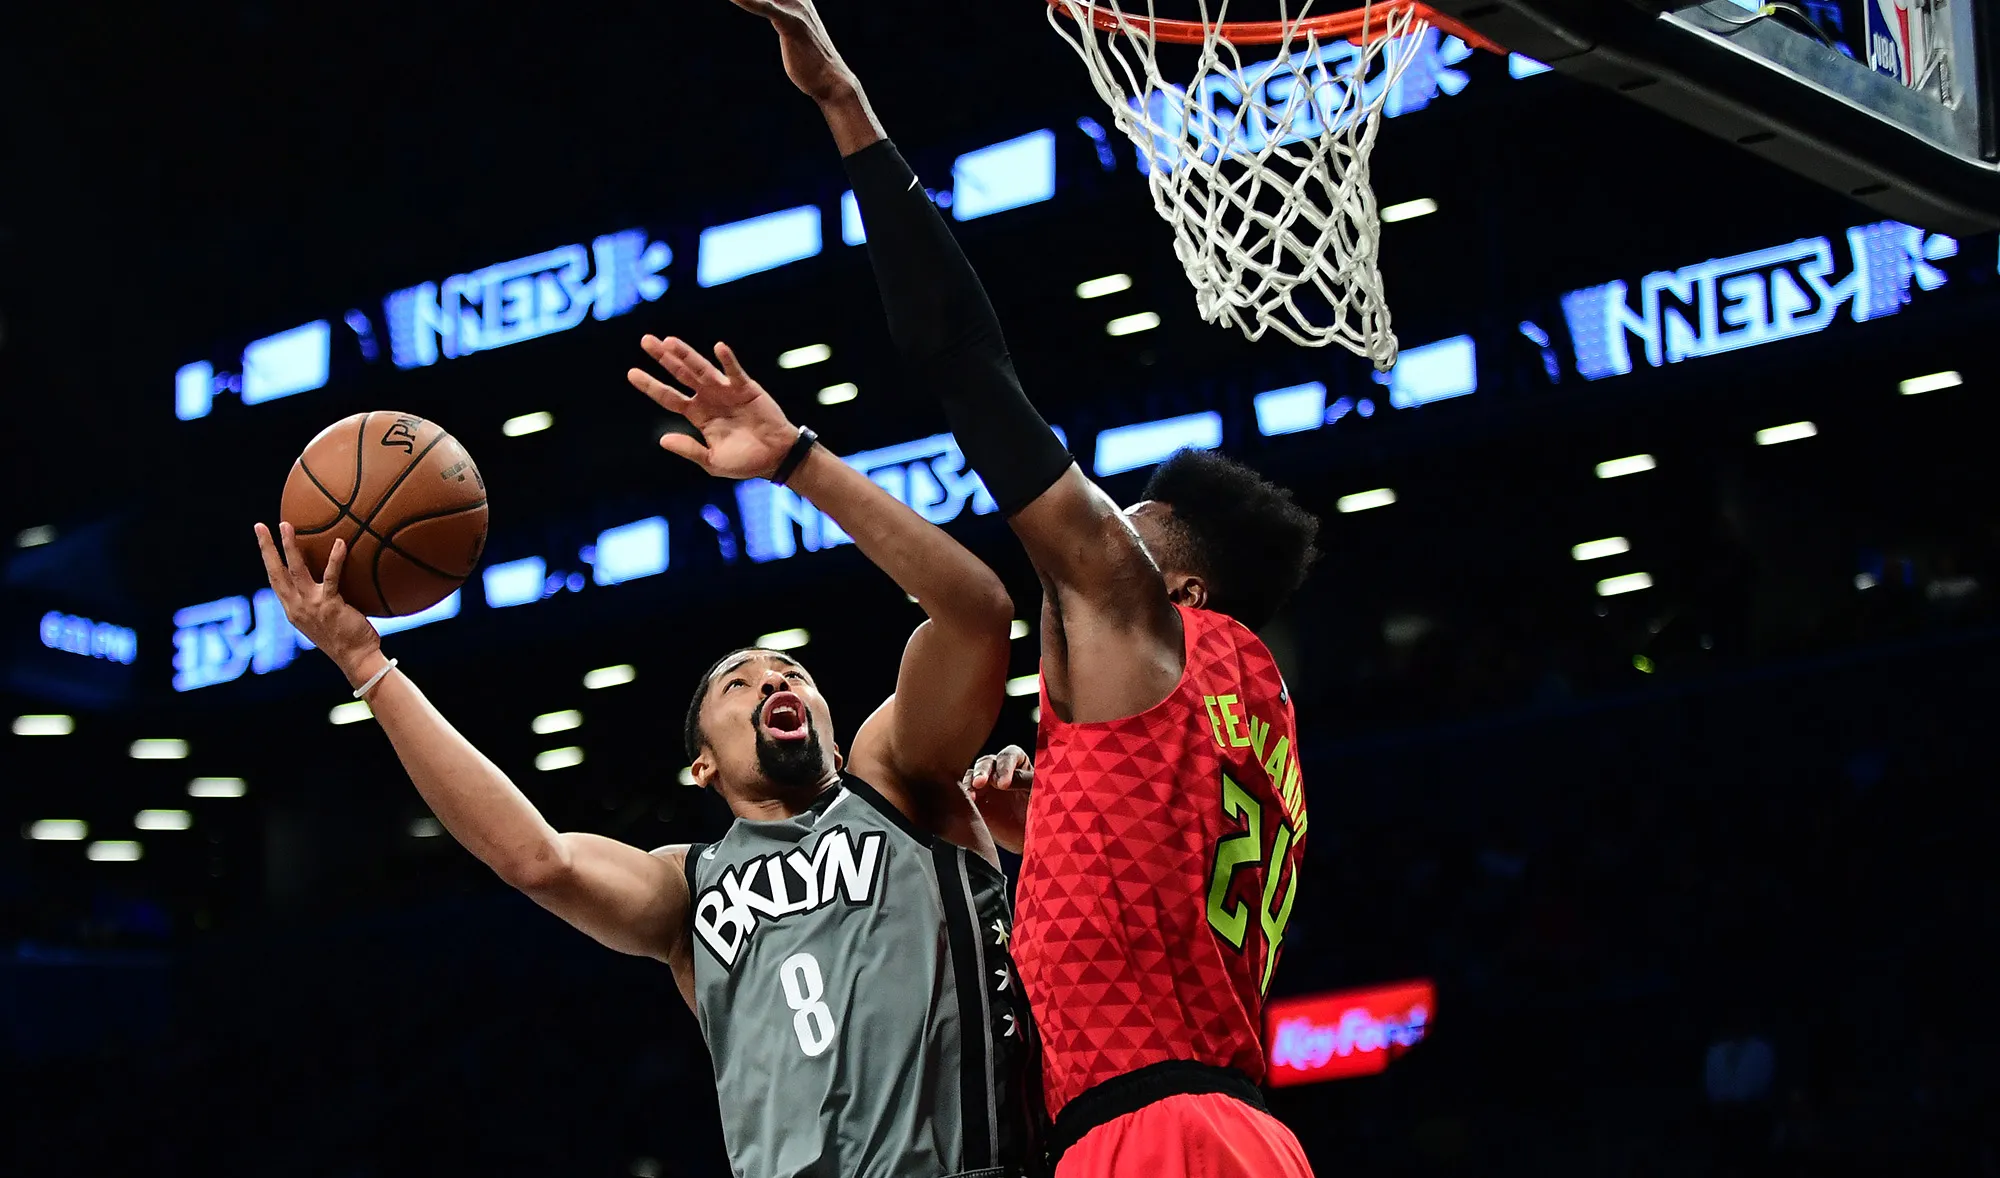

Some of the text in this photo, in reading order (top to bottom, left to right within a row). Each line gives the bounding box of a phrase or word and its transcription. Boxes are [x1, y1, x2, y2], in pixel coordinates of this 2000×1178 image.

[1872, 32, 1898, 77] NBA
[693, 825, 887, 973] BKLYN
[1207, 772, 1298, 997] 24
[780, 952, 835, 1057] 8
